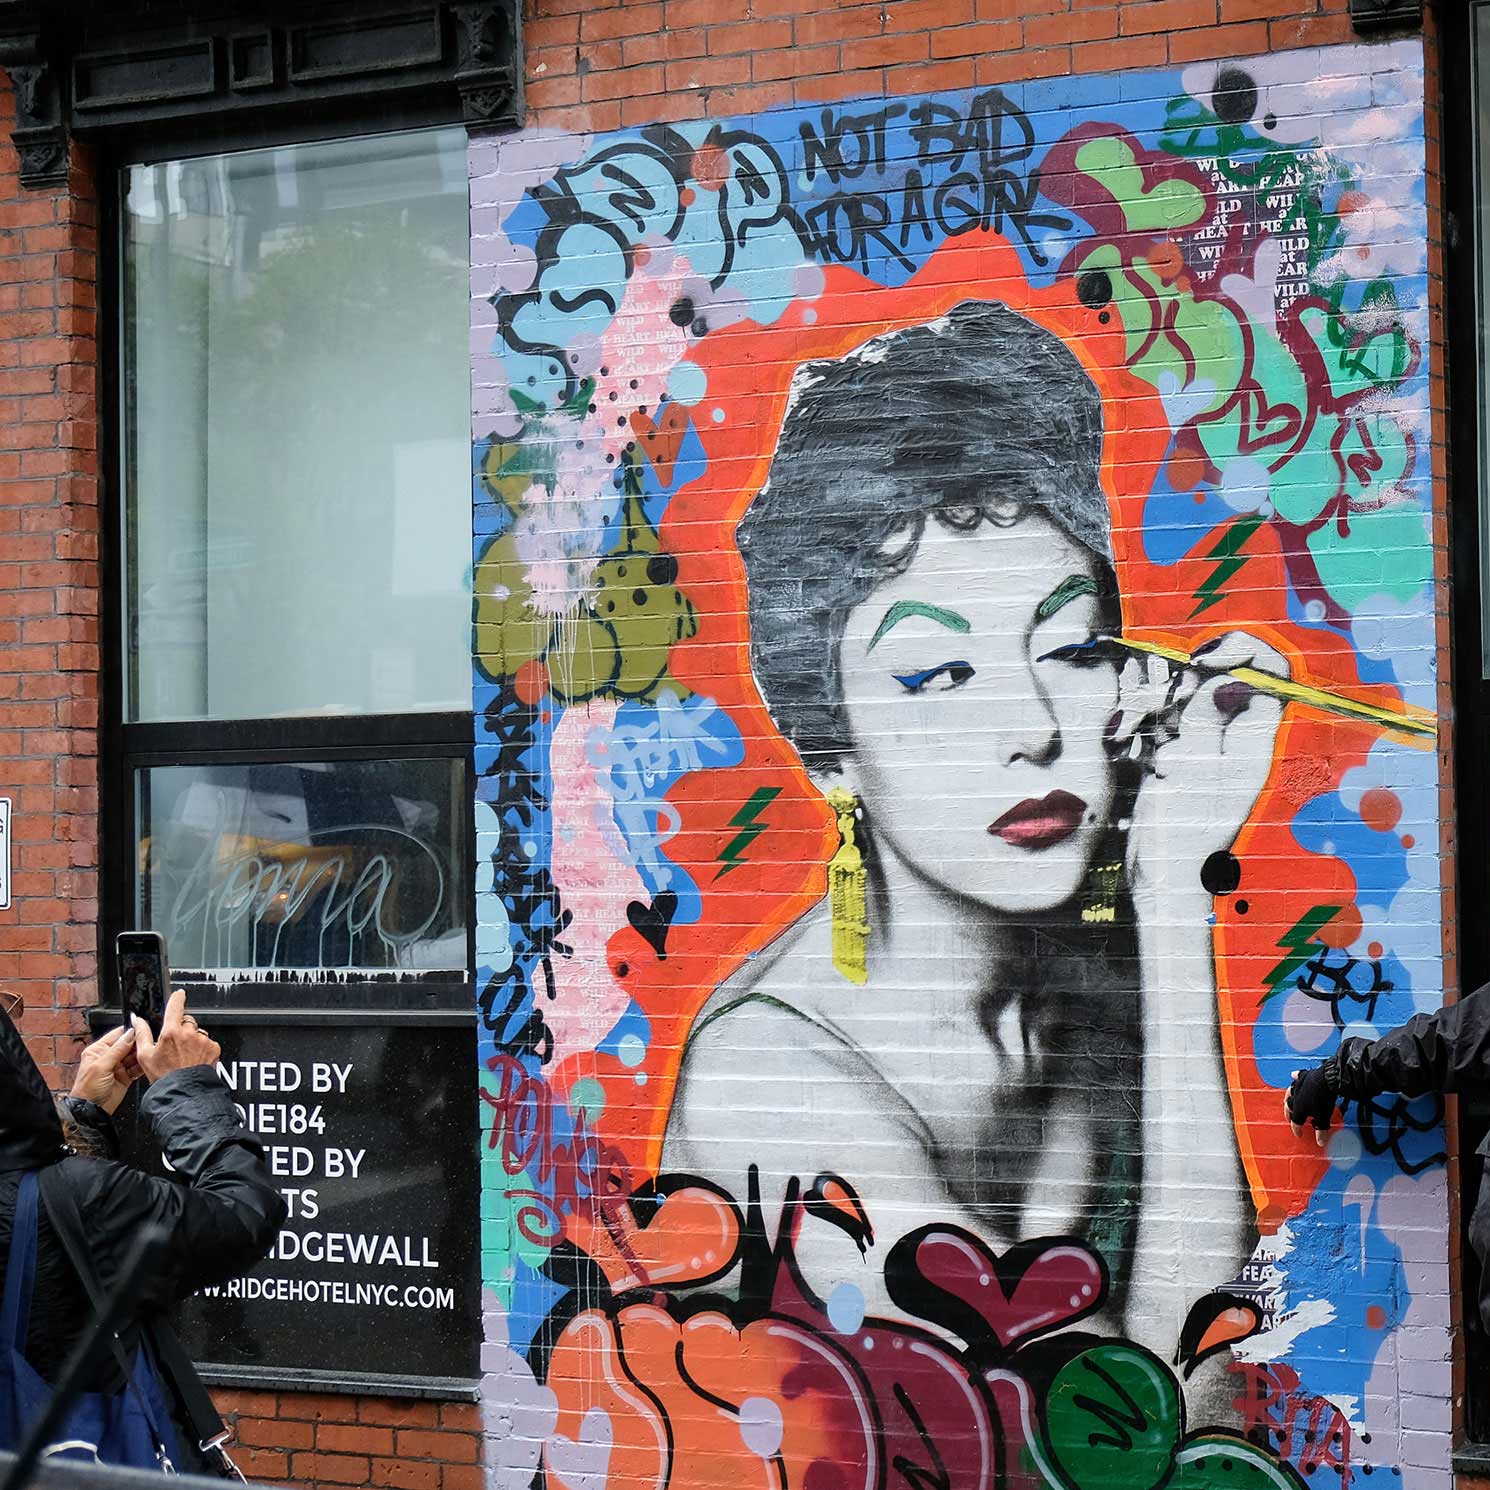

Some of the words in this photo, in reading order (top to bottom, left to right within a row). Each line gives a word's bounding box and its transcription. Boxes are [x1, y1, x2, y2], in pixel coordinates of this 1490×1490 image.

[799, 103, 907, 184] NOT
[908, 88, 1035, 174] BAD
[215, 1061, 301, 1092] NTED
[312, 1063, 353, 1093] BY
[232, 1103, 326, 1135] DIE184
[325, 1149, 366, 1179] BY
[281, 1188, 320, 1220] TS
